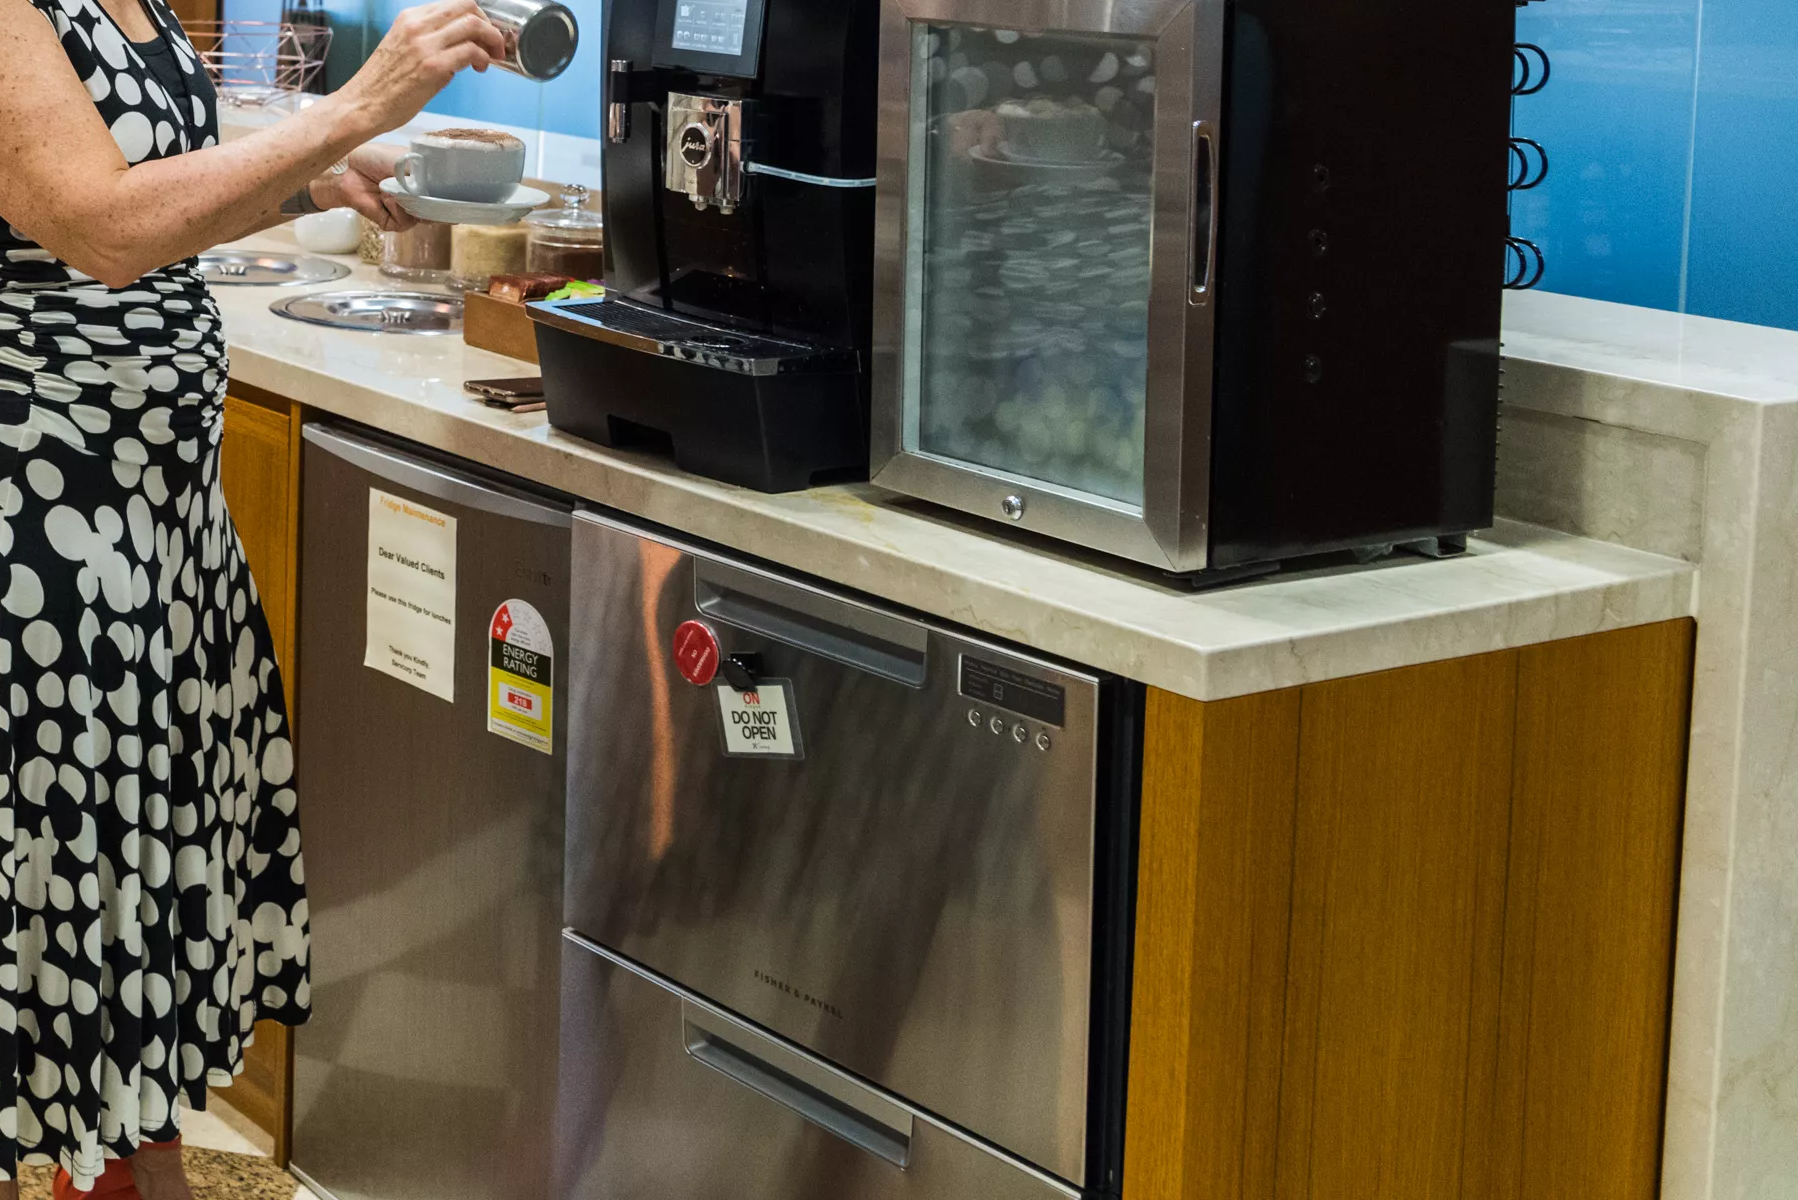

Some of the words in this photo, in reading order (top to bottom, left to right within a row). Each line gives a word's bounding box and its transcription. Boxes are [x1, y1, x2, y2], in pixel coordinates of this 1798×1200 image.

[682, 137, 705, 152] jura
[380, 495, 401, 514] Fridge
[402, 503, 446, 528] Maintenance
[378, 546, 394, 560] Dear
[396, 553, 419, 570] Valued
[421, 562, 445, 580] Clients
[371, 587, 387, 599] Please
[397, 598, 407, 607] this
[408, 602, 422, 614] fridge
[423, 608, 431, 616] for
[388, 644, 403, 657] Thank
[404, 653, 412, 662] you
[502, 644, 539, 665] ENERGY
[413, 668, 427, 680] Team
[503, 657, 538, 678] RATING
[743, 691, 760, 705] ON
[731, 711, 750, 725] DO
[752, 711, 777, 725] NOT
[742, 726, 777, 740] OPEN
[754, 970, 790, 994] FISHER
[804, 994, 843, 1019] PAYKEL
